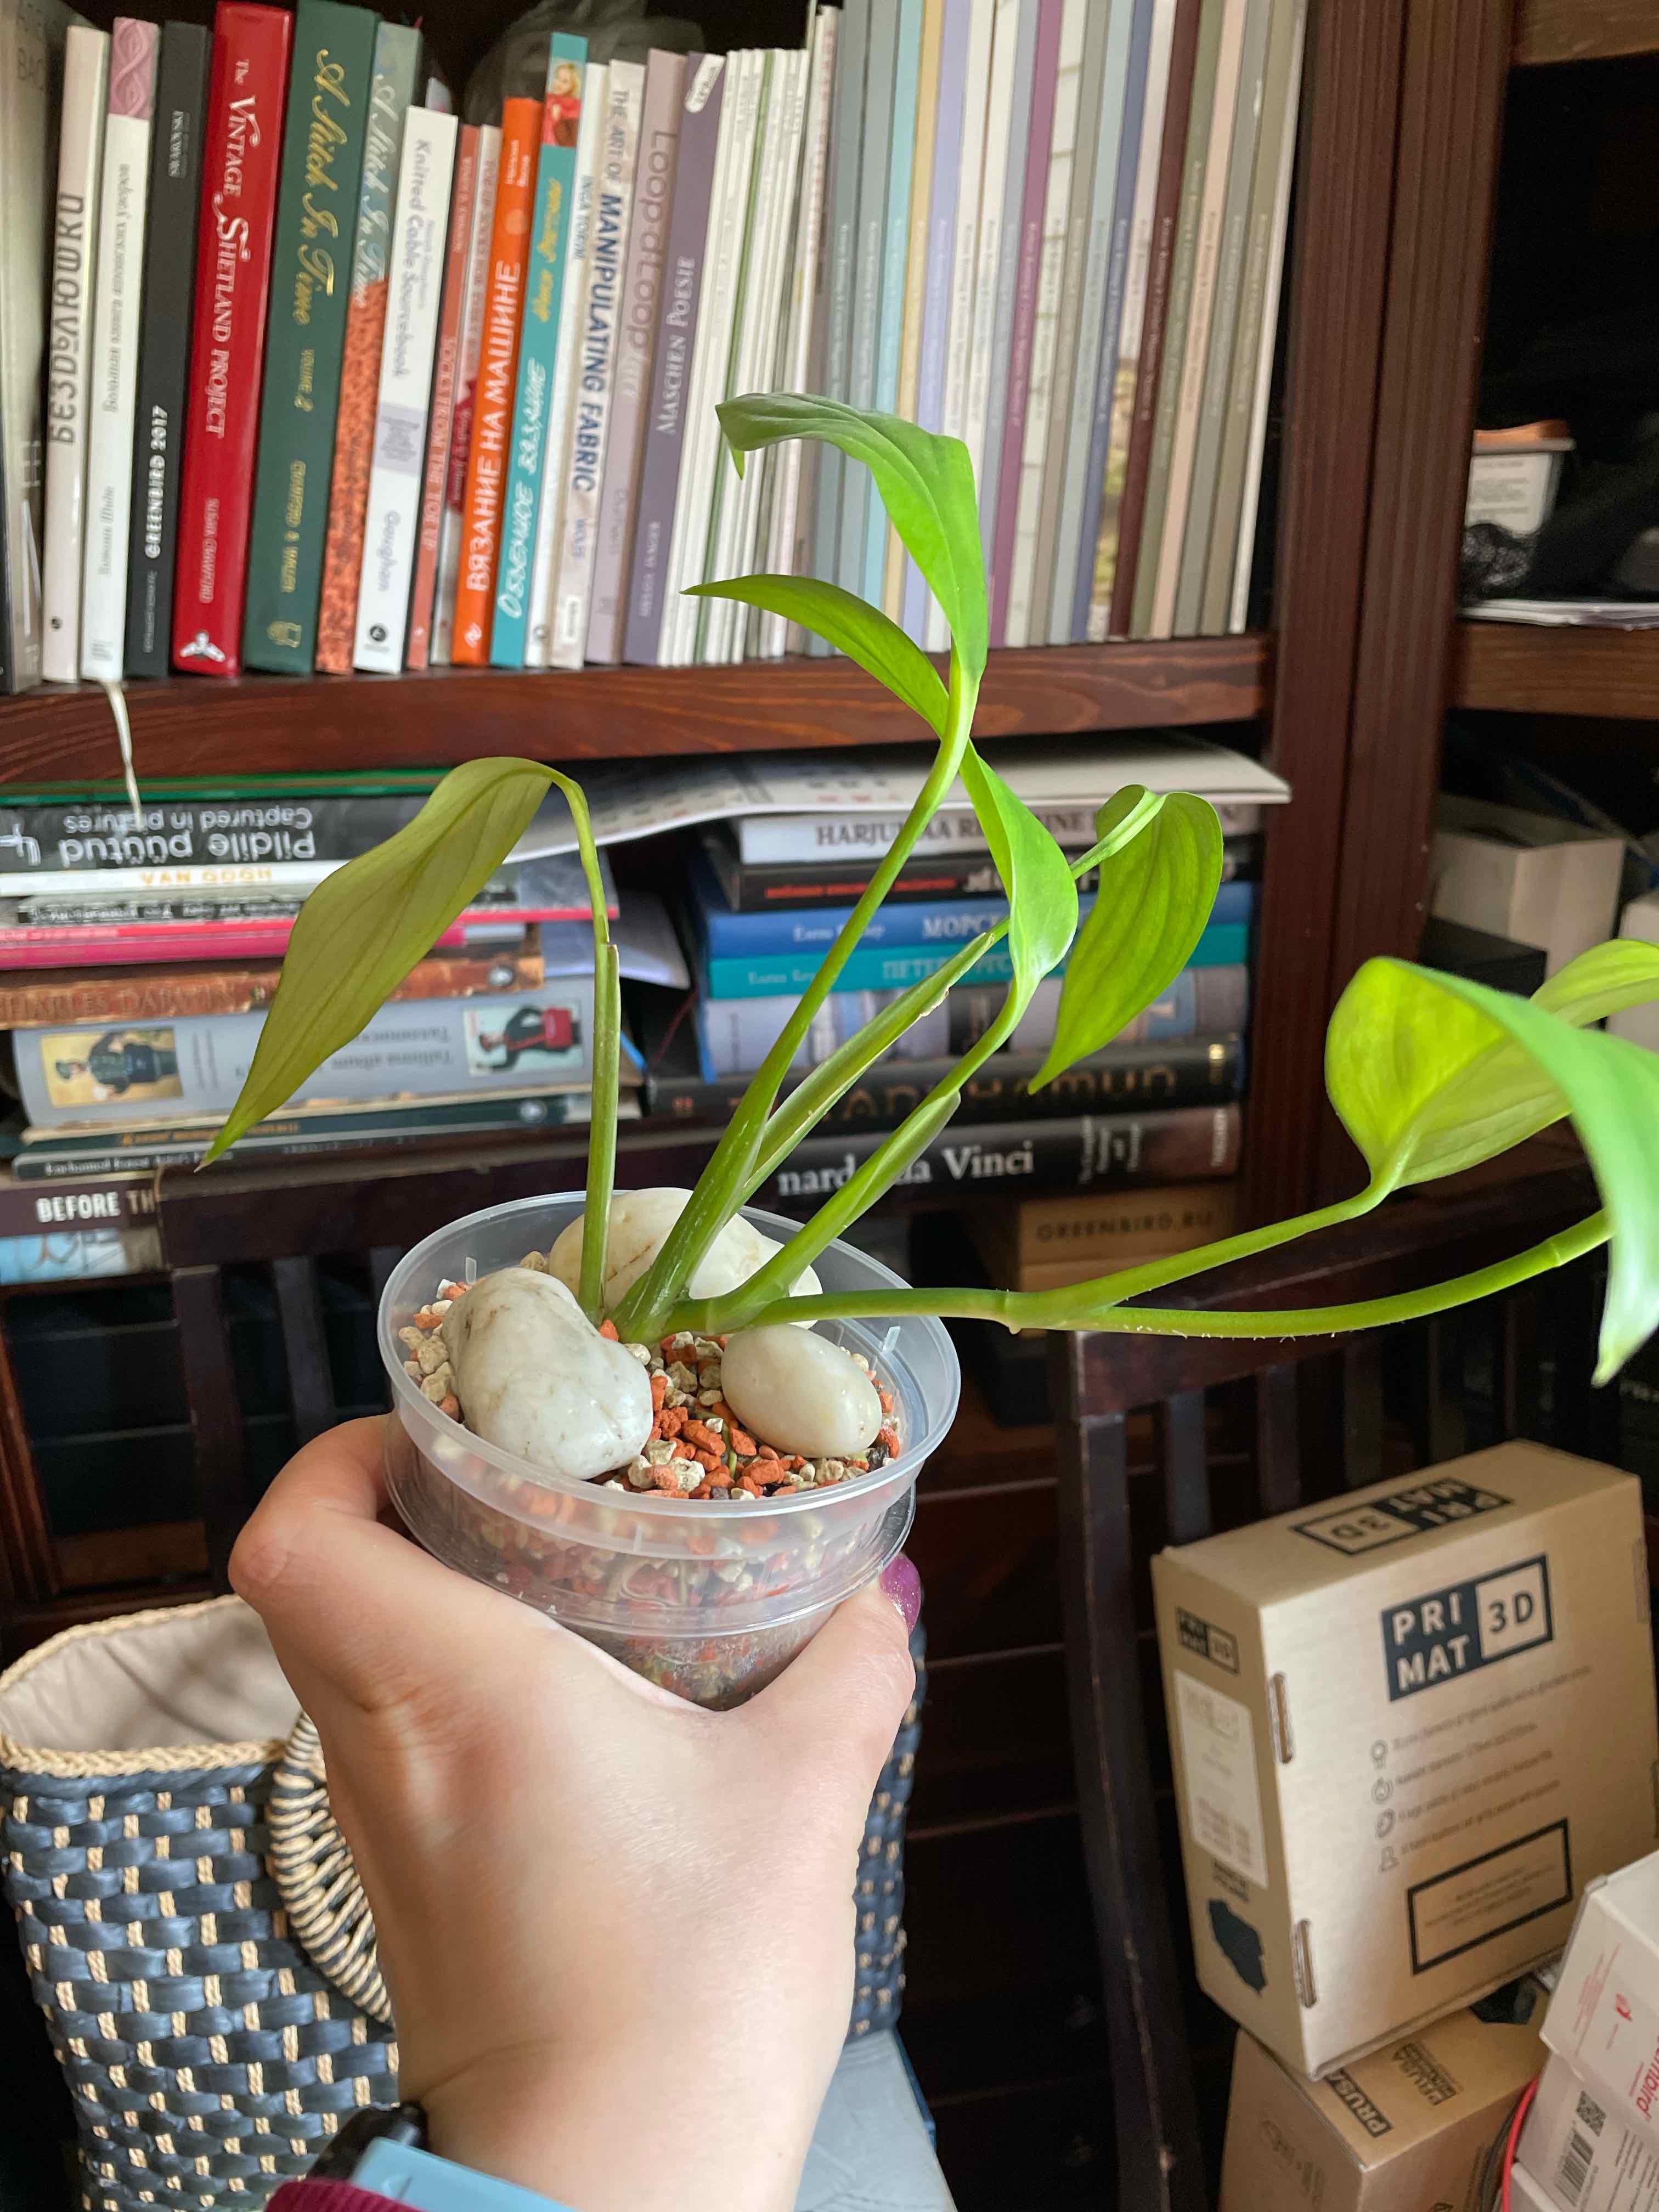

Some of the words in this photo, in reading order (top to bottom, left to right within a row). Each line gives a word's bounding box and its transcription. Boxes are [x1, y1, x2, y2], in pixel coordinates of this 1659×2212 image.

[315, 49, 351, 106] A
[369, 73, 399, 121] A
[223, 96, 261, 198] VINTAGE
[304, 95, 348, 191] Stitch
[362, 113, 397, 193] Stitch
[608, 126, 626, 156] ART
[409, 138, 433, 212] Knitted
[300, 193, 339, 238] In
[359, 195, 390, 235] In
[404, 213, 426, 268] Cable
[211, 193, 251, 343] SHETLAND
[292, 244, 334, 325] Time
[352, 239, 387, 309] Time
[584, 193, 623, 393] MANIPULATING
[485, 261, 521, 405] МАШИНЕ
[206, 349, 229, 438] PROJECT
[151, 405, 168, 450] 2017
[480, 409, 504, 452] НА
[572, 402, 603, 493] FABRIC
[145, 455, 165, 558] GREENBIRD
[466, 456, 502, 592] ВЯЗАНИЕ
[171, 811, 193, 831] in
[200, 805, 313, 833] Captured
[208, 831, 316, 860] Pildile
[59, 830, 193, 868] püütud
[140, 871, 191, 886] VAN
[201, 868, 273, 883] GOGH
[0, 989, 109, 1020] HARLES
[943, 1139, 1035, 1181] Vinci
[36, 1190, 121, 1224] BEFORE
[126, 1188, 158, 1215] TH
[1392, 1592, 1462, 1645] PRI
[1488, 1592, 1534, 1633] 3D
[1396, 1633, 1471, 1692] MAT
